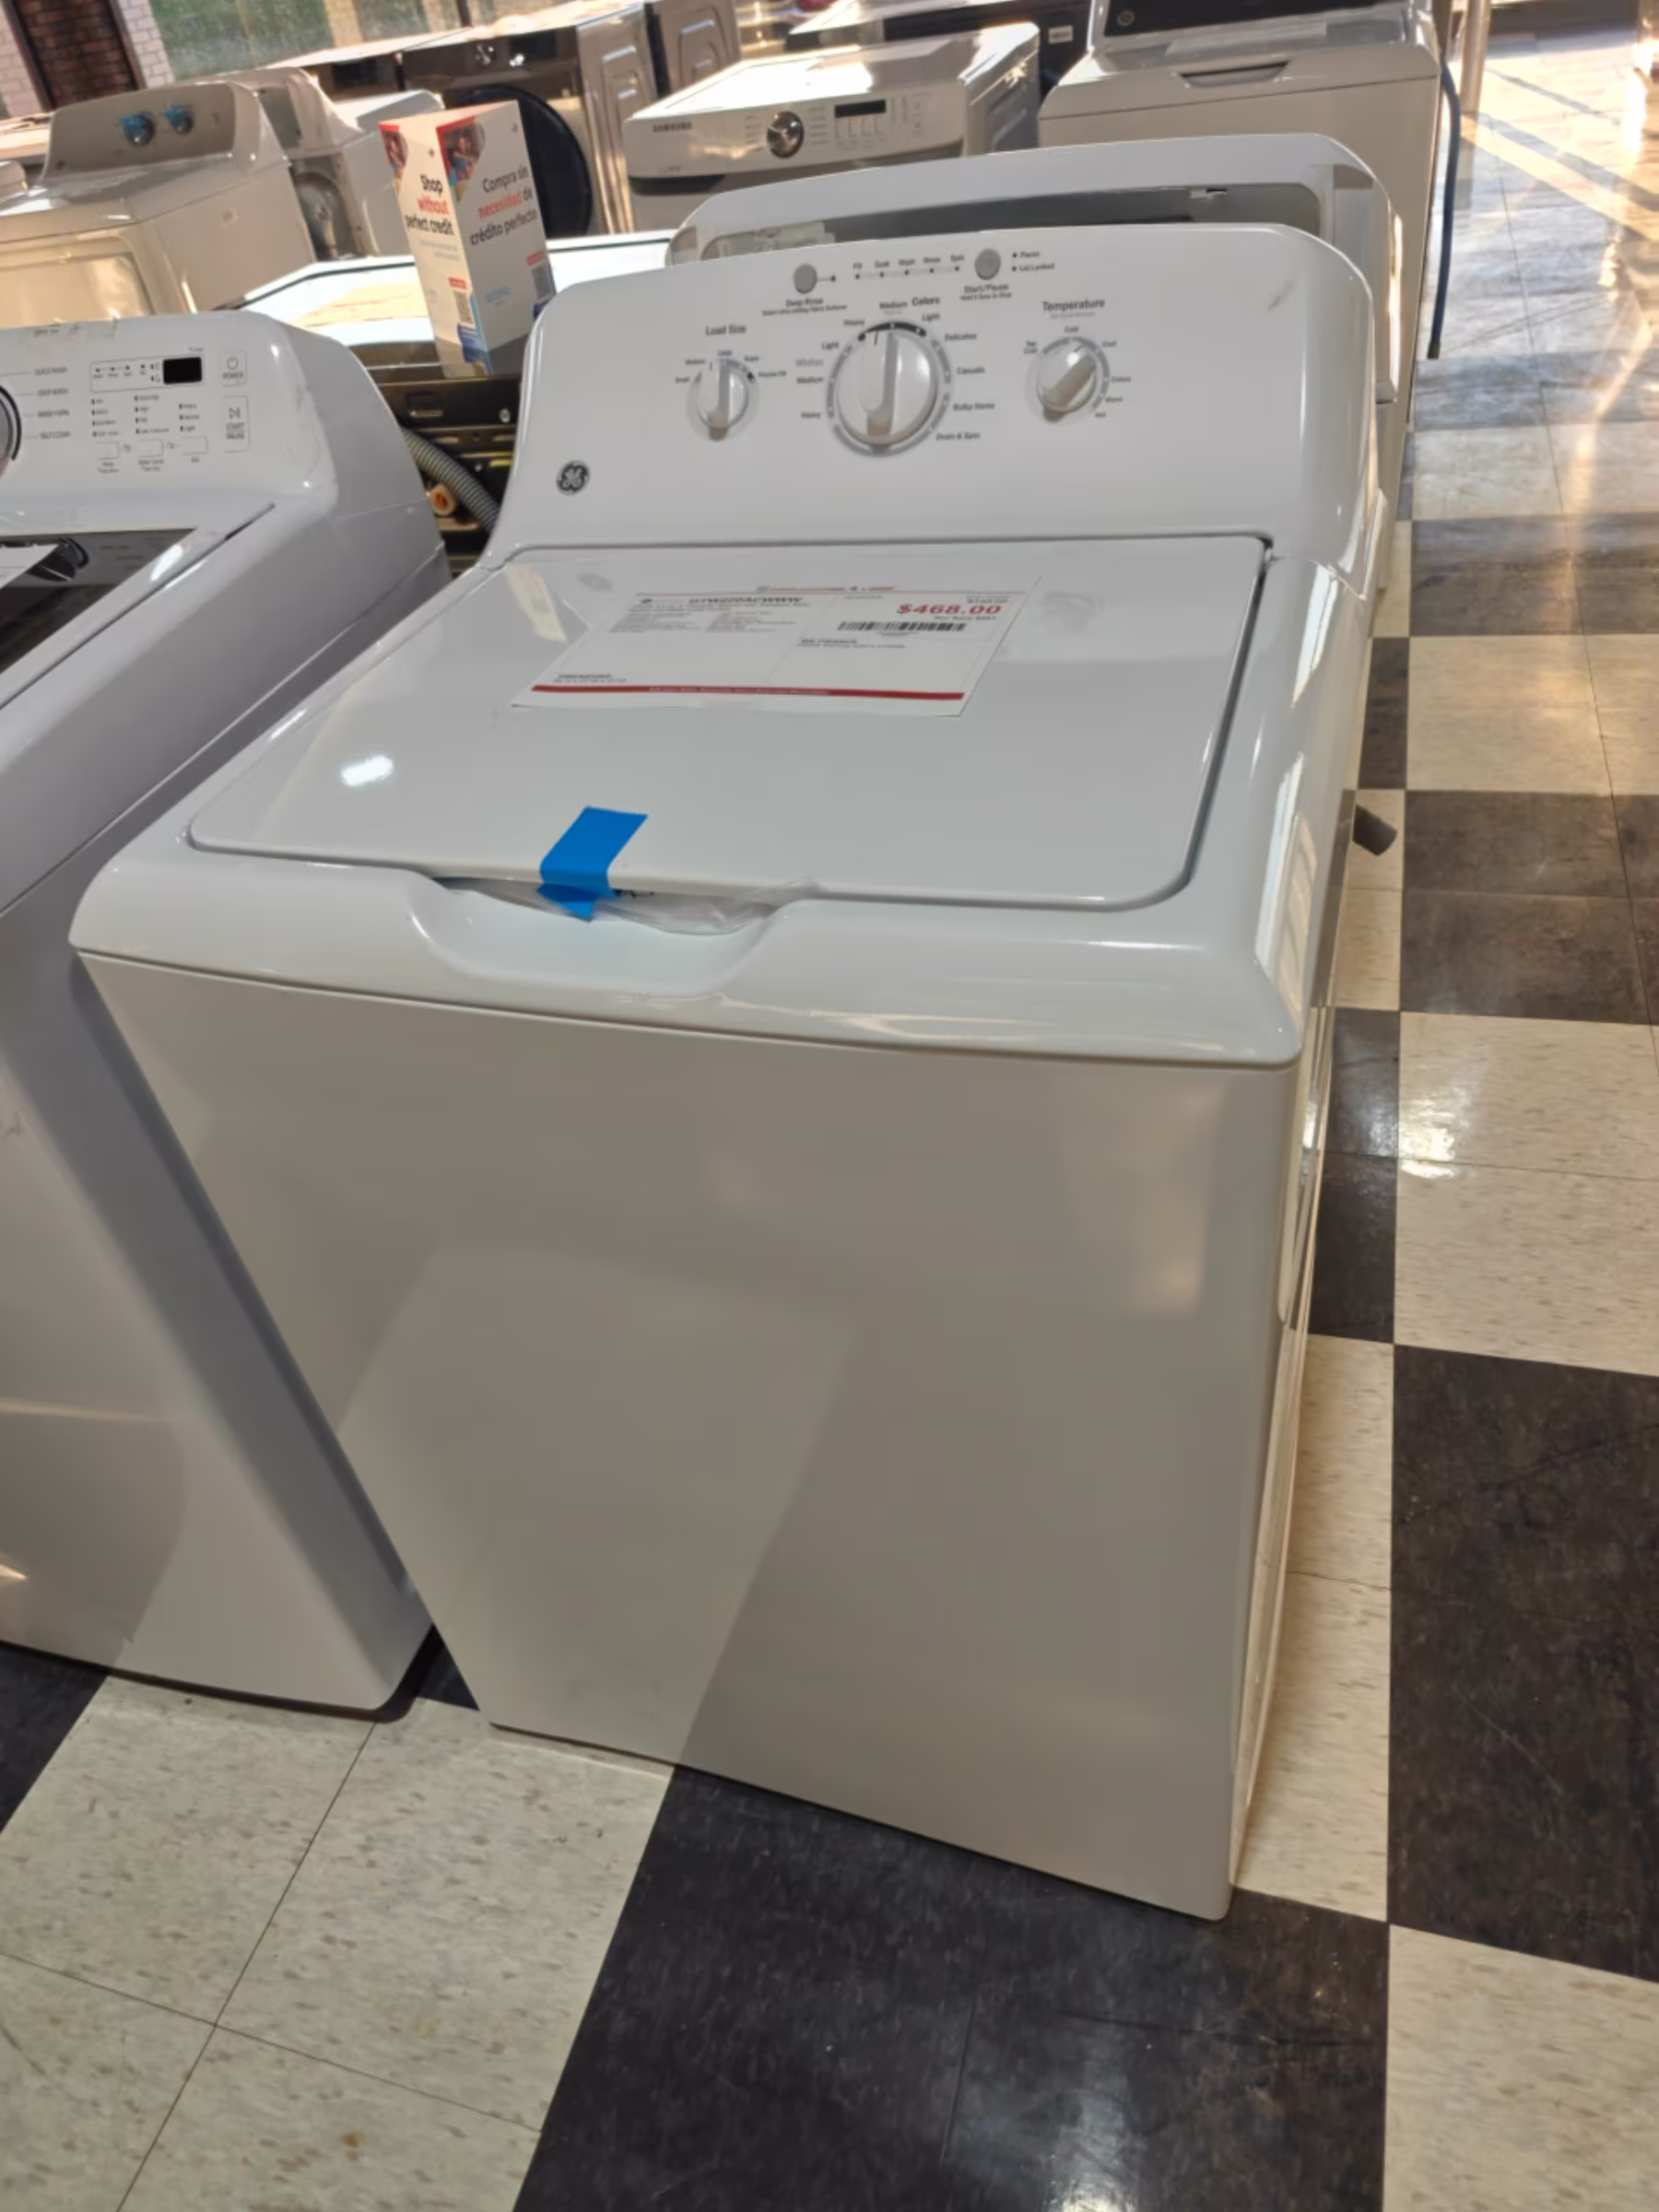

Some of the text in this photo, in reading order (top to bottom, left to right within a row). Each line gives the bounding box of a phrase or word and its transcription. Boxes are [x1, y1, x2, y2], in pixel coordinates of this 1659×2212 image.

[420, 173, 442, 195] Shop
[482, 164, 529, 194] Compra sin
[417, 195, 450, 215] without
[477, 186, 533, 218] necesidad de
[405, 214, 429, 230] perfect
[470, 209, 537, 245] crédito perfecto
[964, 283, 1009, 294] Start/Pause
[879, 296, 940, 310] Medium Colors
[1041, 298, 1105, 312] Temperature
[705, 324, 746, 335] Load Size
[944, 333, 977, 341] Delicates
[897, 604, 1002, 615] $468.00
